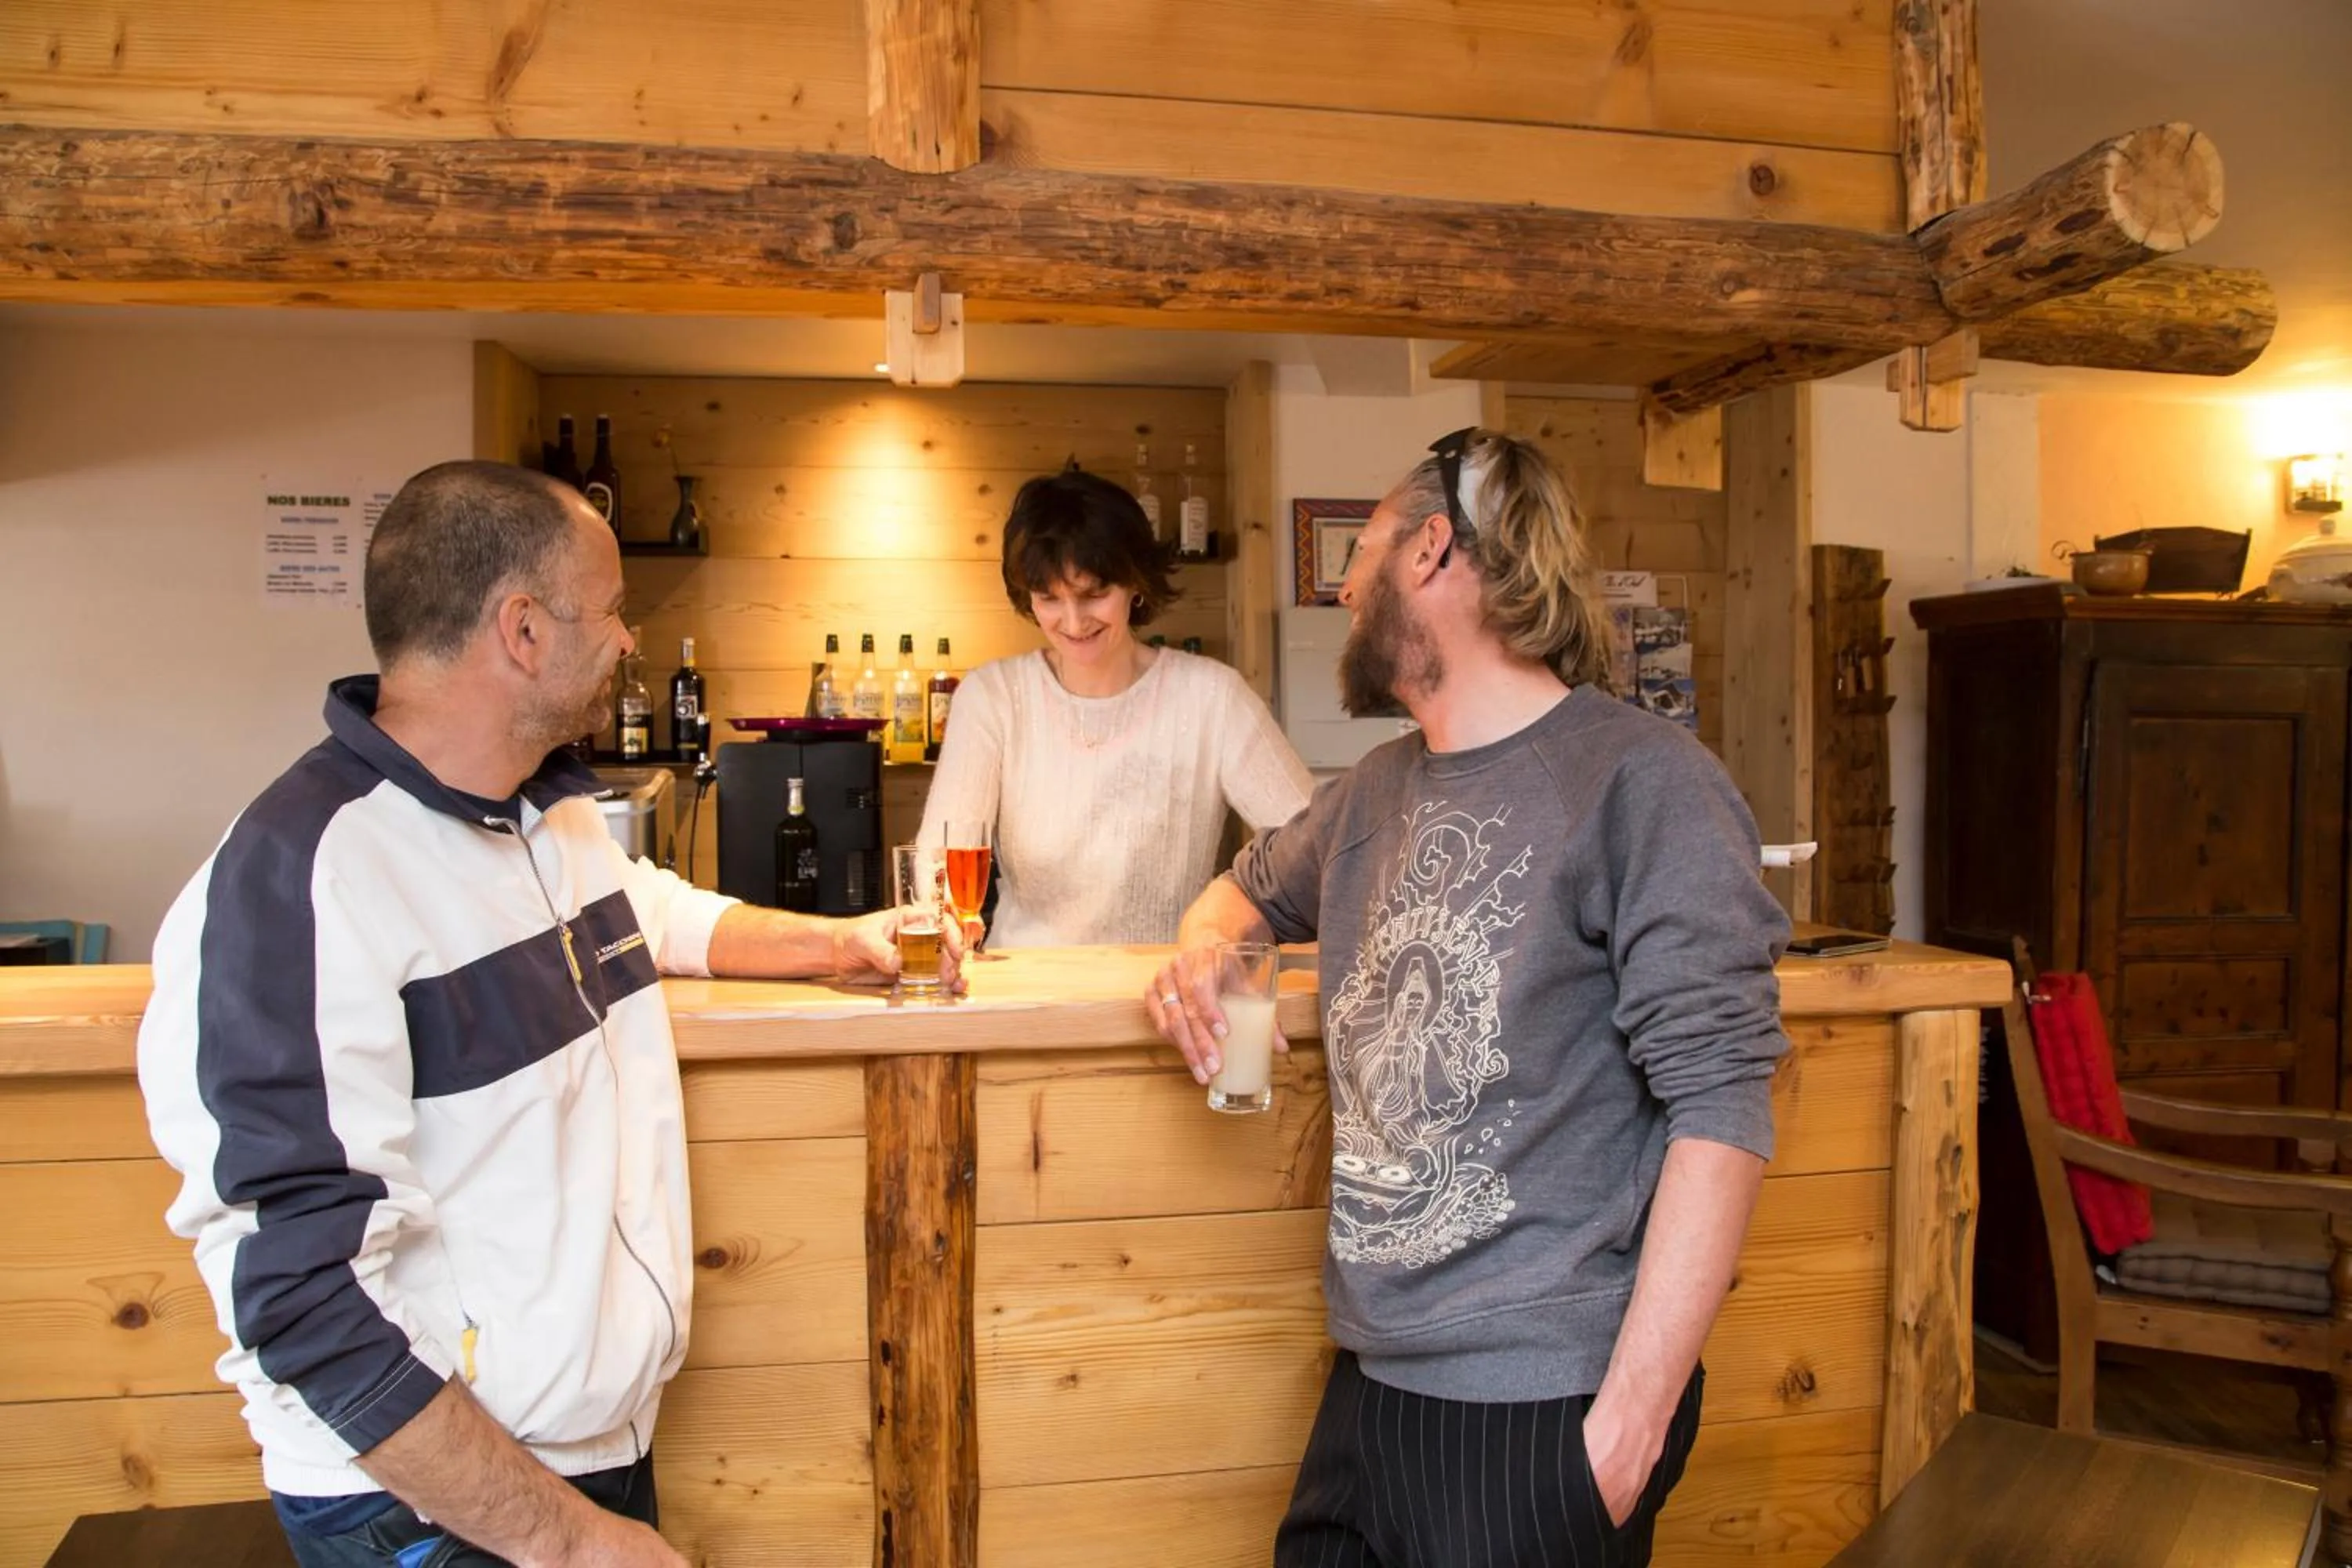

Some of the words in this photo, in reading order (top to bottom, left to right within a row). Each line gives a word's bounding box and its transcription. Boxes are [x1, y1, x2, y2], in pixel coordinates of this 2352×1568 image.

[267, 495, 296, 506] NOS
[300, 496, 350, 507] BIERES
[677, 699, 696, 716] 51
